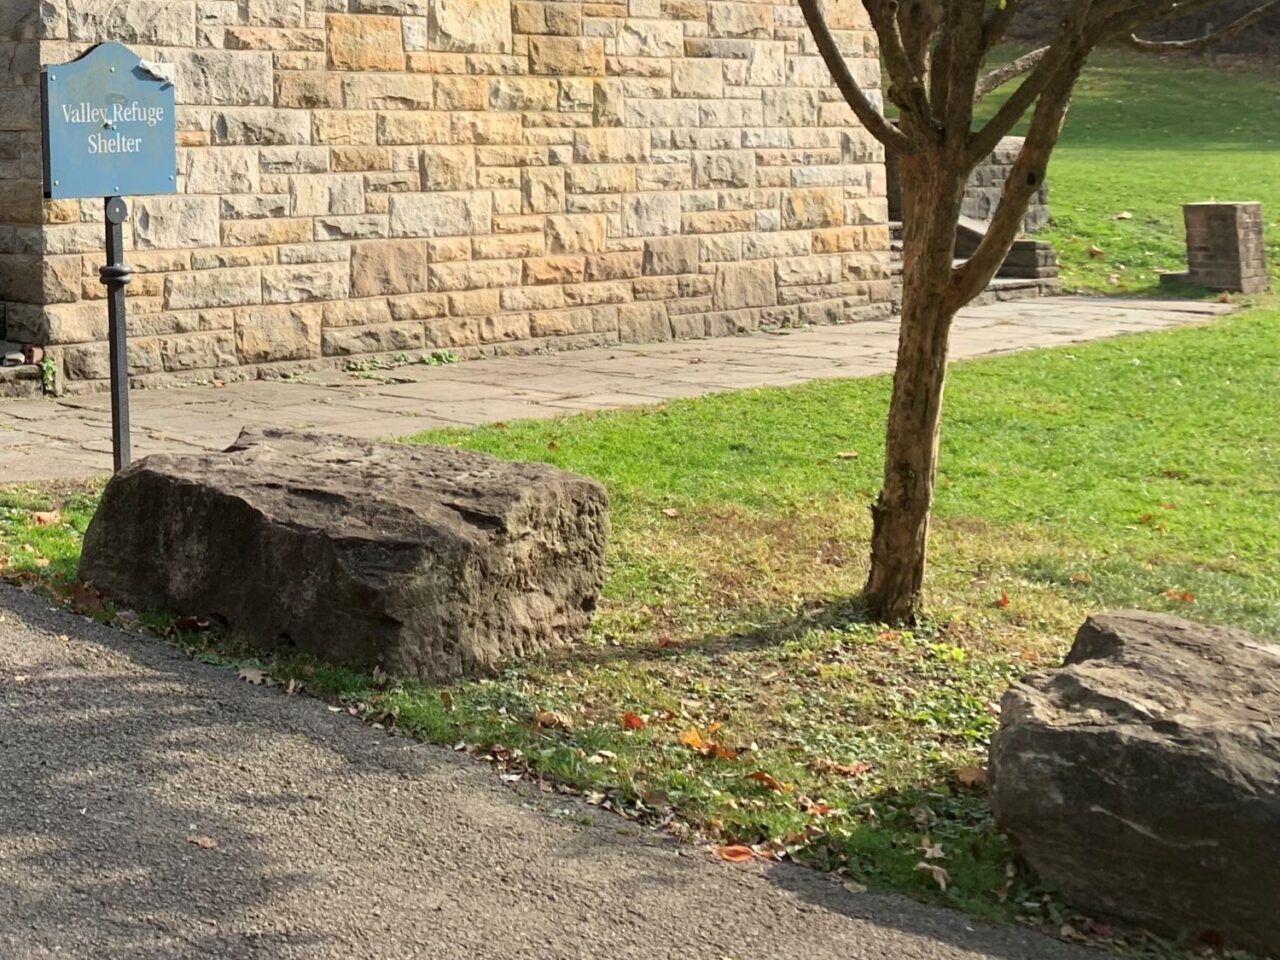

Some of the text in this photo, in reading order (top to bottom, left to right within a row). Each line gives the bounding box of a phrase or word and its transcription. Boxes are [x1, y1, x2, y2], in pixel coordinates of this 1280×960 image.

[62, 101, 164, 127] Valley Refuge
[88, 133, 142, 154] Shelter
